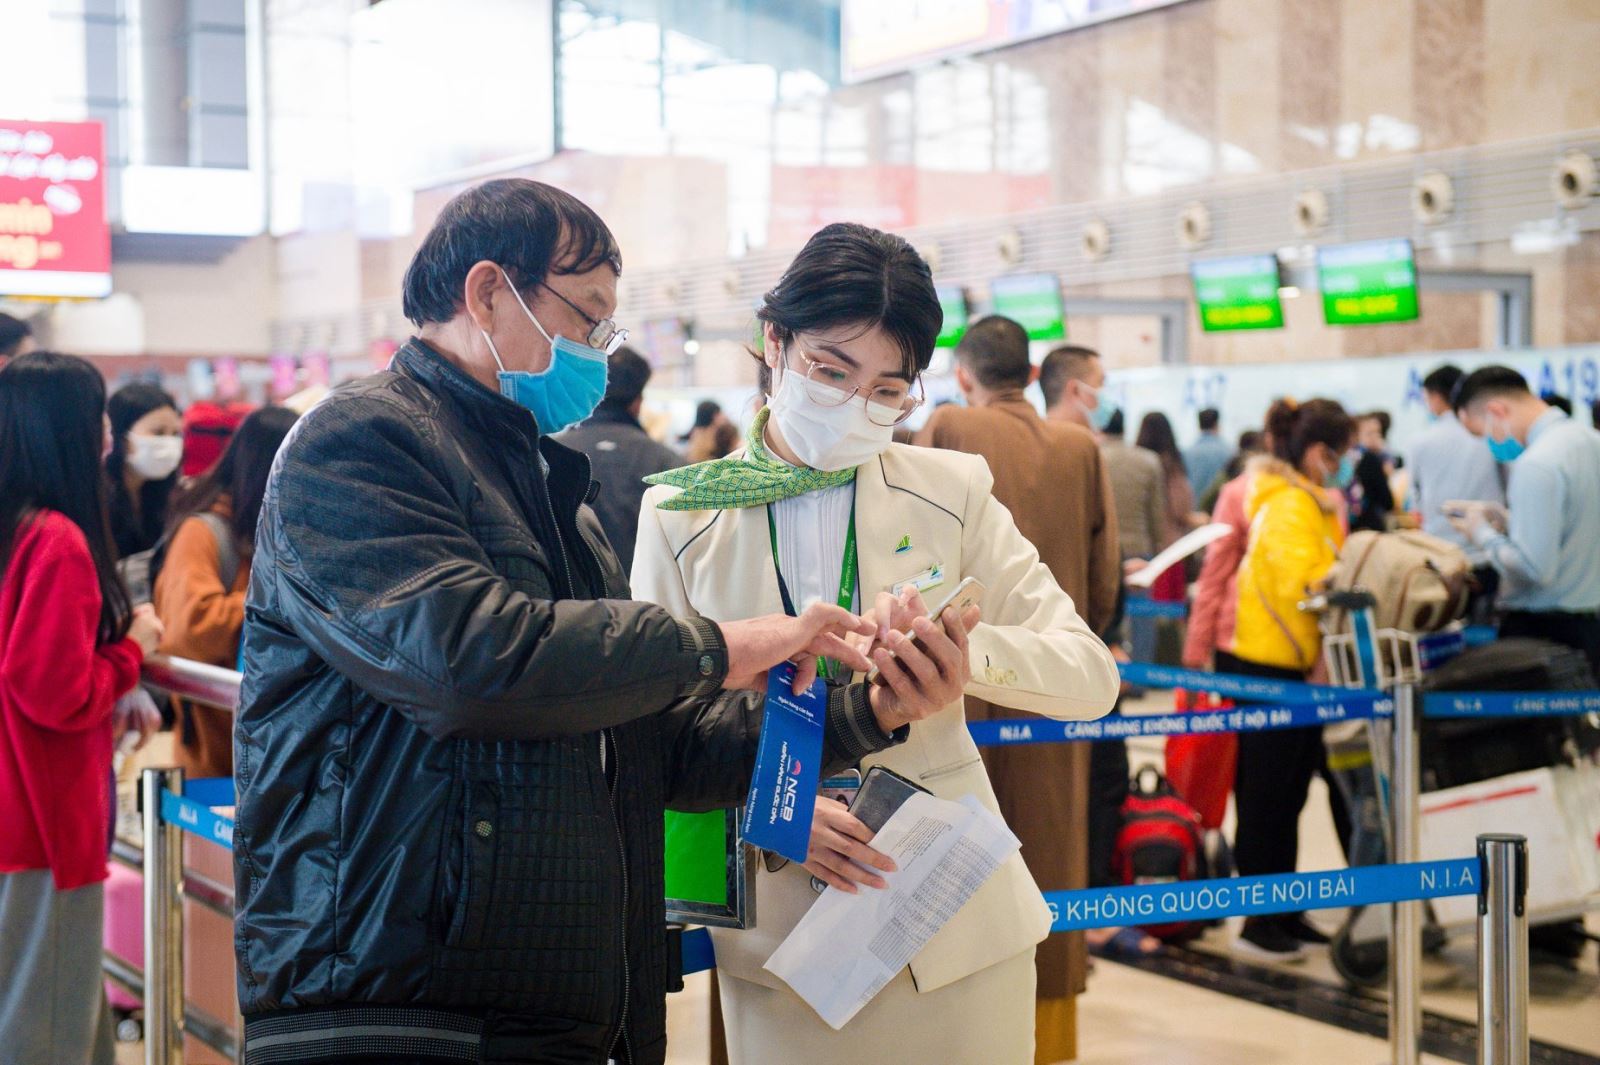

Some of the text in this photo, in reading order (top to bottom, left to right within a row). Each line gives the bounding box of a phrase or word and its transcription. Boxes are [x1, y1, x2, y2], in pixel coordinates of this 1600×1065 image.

[1000, 726, 1032, 741] N.I.A
[783, 777, 798, 822] NCB
[1067, 893, 1154, 921] KHÔNG
[1237, 883, 1265, 905] TẾ
[1272, 879, 1312, 904] NỘI
[1320, 874, 1355, 899] BÀI
[1420, 866, 1474, 890] N.I.A
